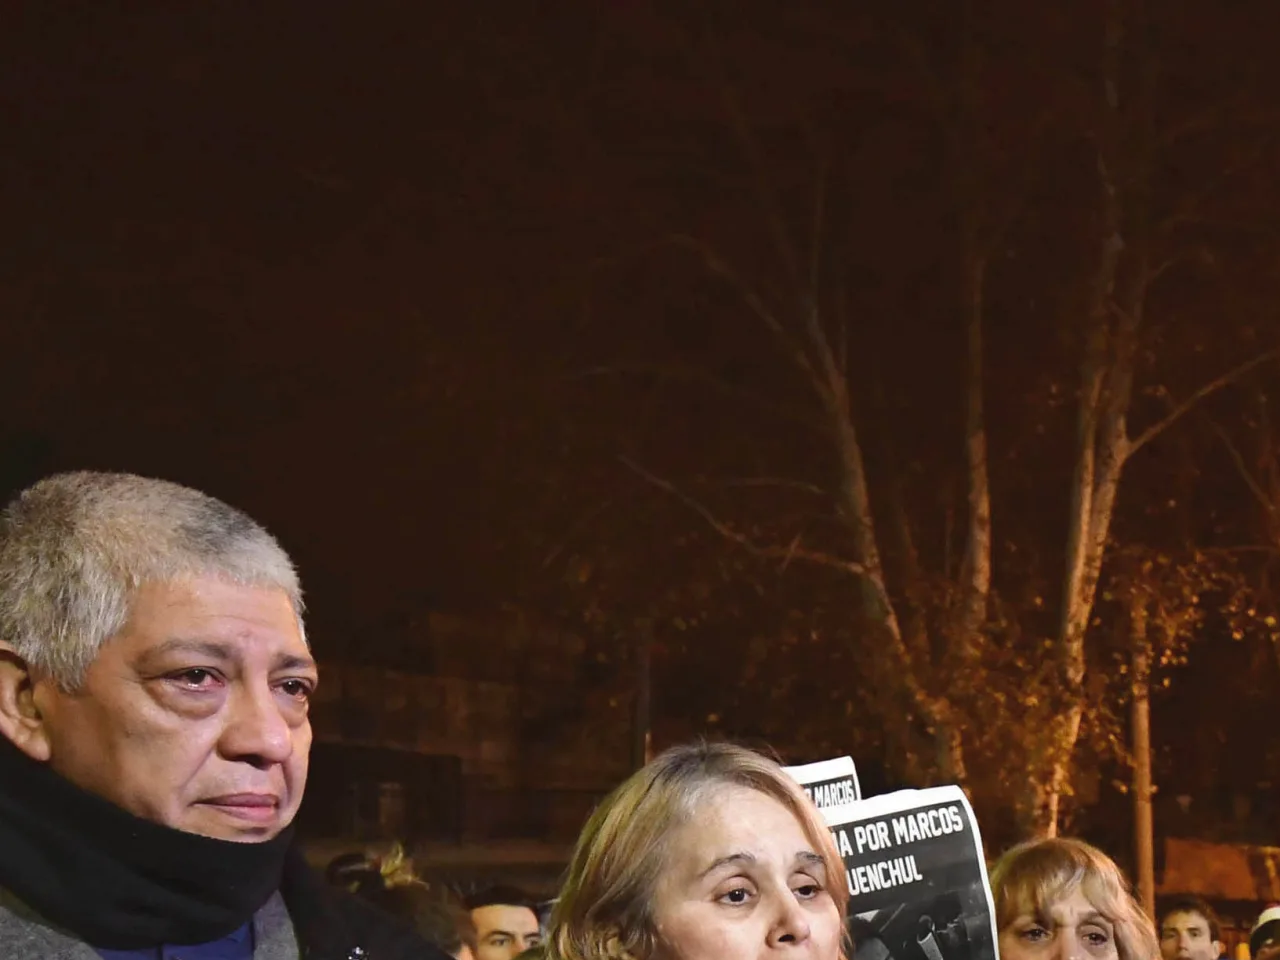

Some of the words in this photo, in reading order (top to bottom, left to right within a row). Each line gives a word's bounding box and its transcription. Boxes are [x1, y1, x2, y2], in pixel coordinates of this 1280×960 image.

[814, 779, 855, 808] MARCOS
[854, 821, 892, 854] POR
[891, 805, 963, 845] MARCOS
[846, 854, 923, 896] UENCHUL
